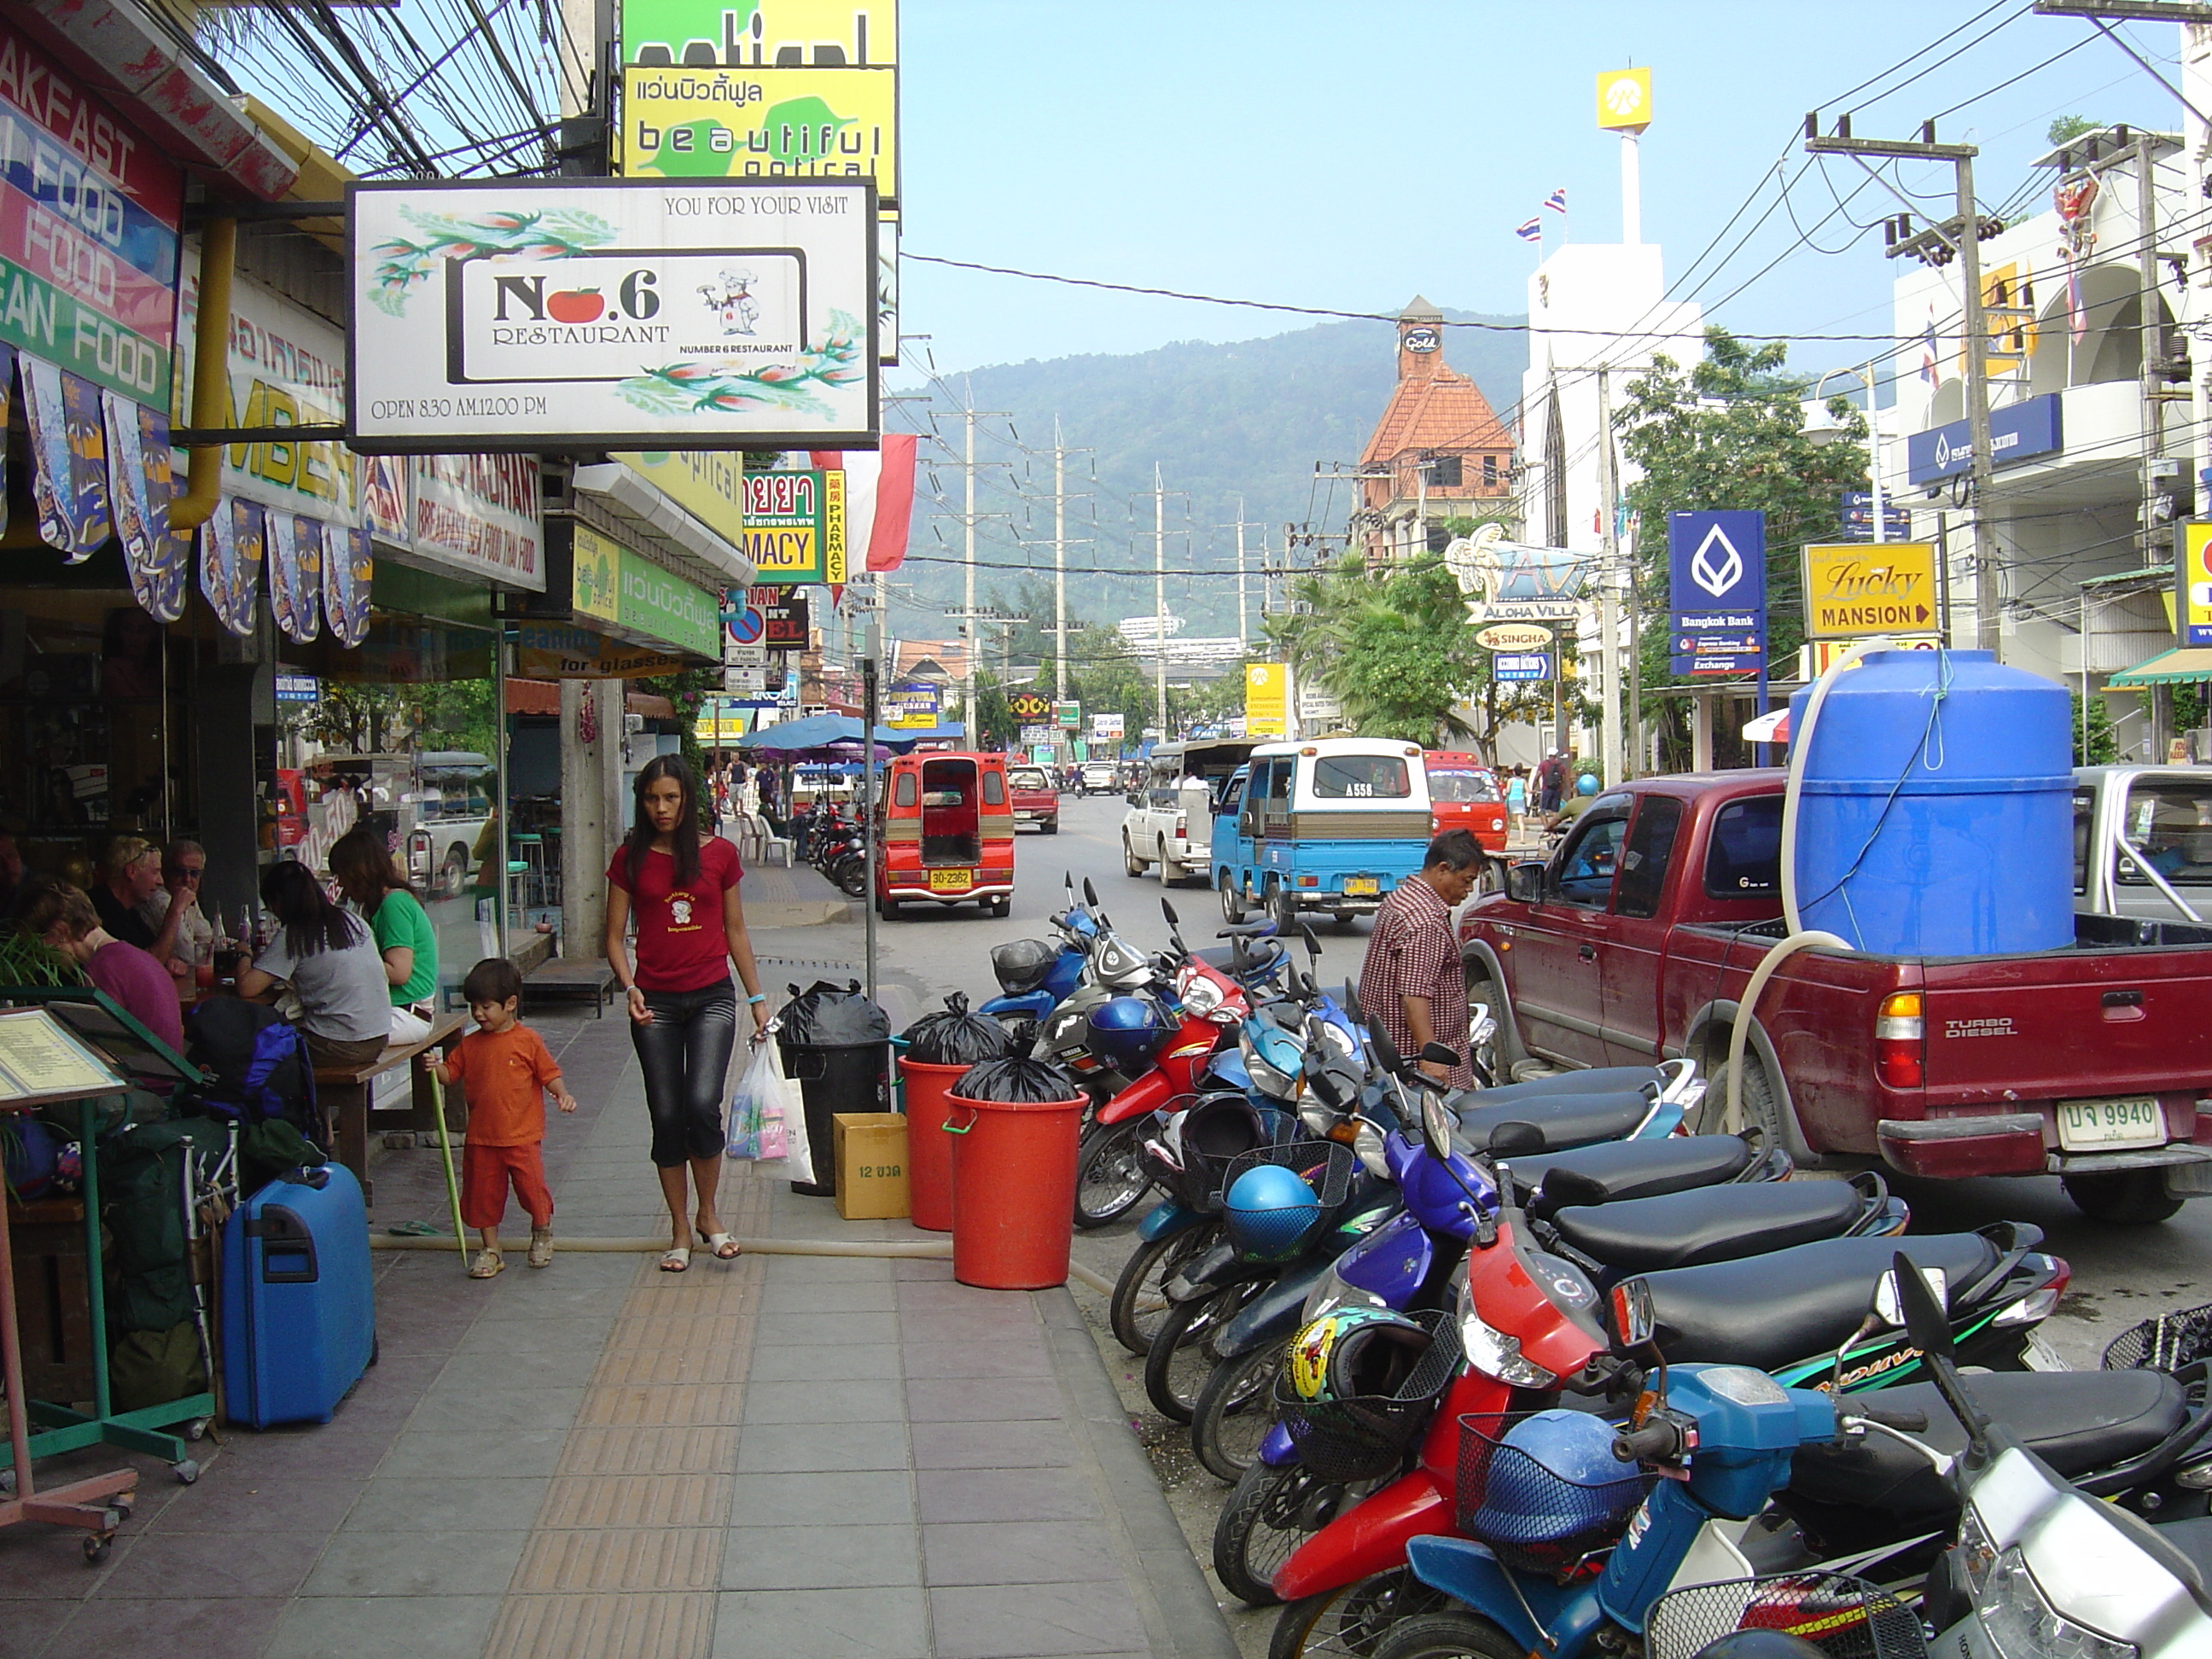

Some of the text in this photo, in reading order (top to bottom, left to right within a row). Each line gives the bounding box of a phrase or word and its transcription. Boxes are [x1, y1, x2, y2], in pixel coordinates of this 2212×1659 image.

[637, 73, 762, 108] แว่นบิวตี้ฟูล
[638, 119, 879, 155] beautiful
[32, 137, 124, 247] FOOD
[665, 195, 848, 215] YOU FOR YOUR VISIT
[24, 206, 116, 308] FOOD
[493, 326, 669, 345] RESTAURANT
[1406, 337, 1437, 351] Gold
[74, 307, 156, 395] FOOD
[679, 344, 793, 353] NUMBER 6 RESTAURANT
[371, 399, 414, 419] OPEN
[419, 399, 451, 417] 8.30
[524, 396, 546, 415] PM
[828, 504, 843, 581] PHARMACY
[1819, 561, 1923, 602] Lucky
[1483, 604, 1581, 620] ALOHA VILLA
[1822, 606, 1911, 626] MANSION
[1681, 616, 1754, 628] Bangkok Bank
[1501, 634, 1546, 643] SINGHA
[561, 657, 589, 671] for
[1694, 661, 1735, 670] Exchange
[1346, 783, 1372, 797] A558
[1946, 1017, 2013, 1029] TURBO
[1945, 1027, 2019, 1039] DIESEL
[2066, 1103, 2153, 1128] บจ 9940
[859, 1167, 872, 1178] 12
